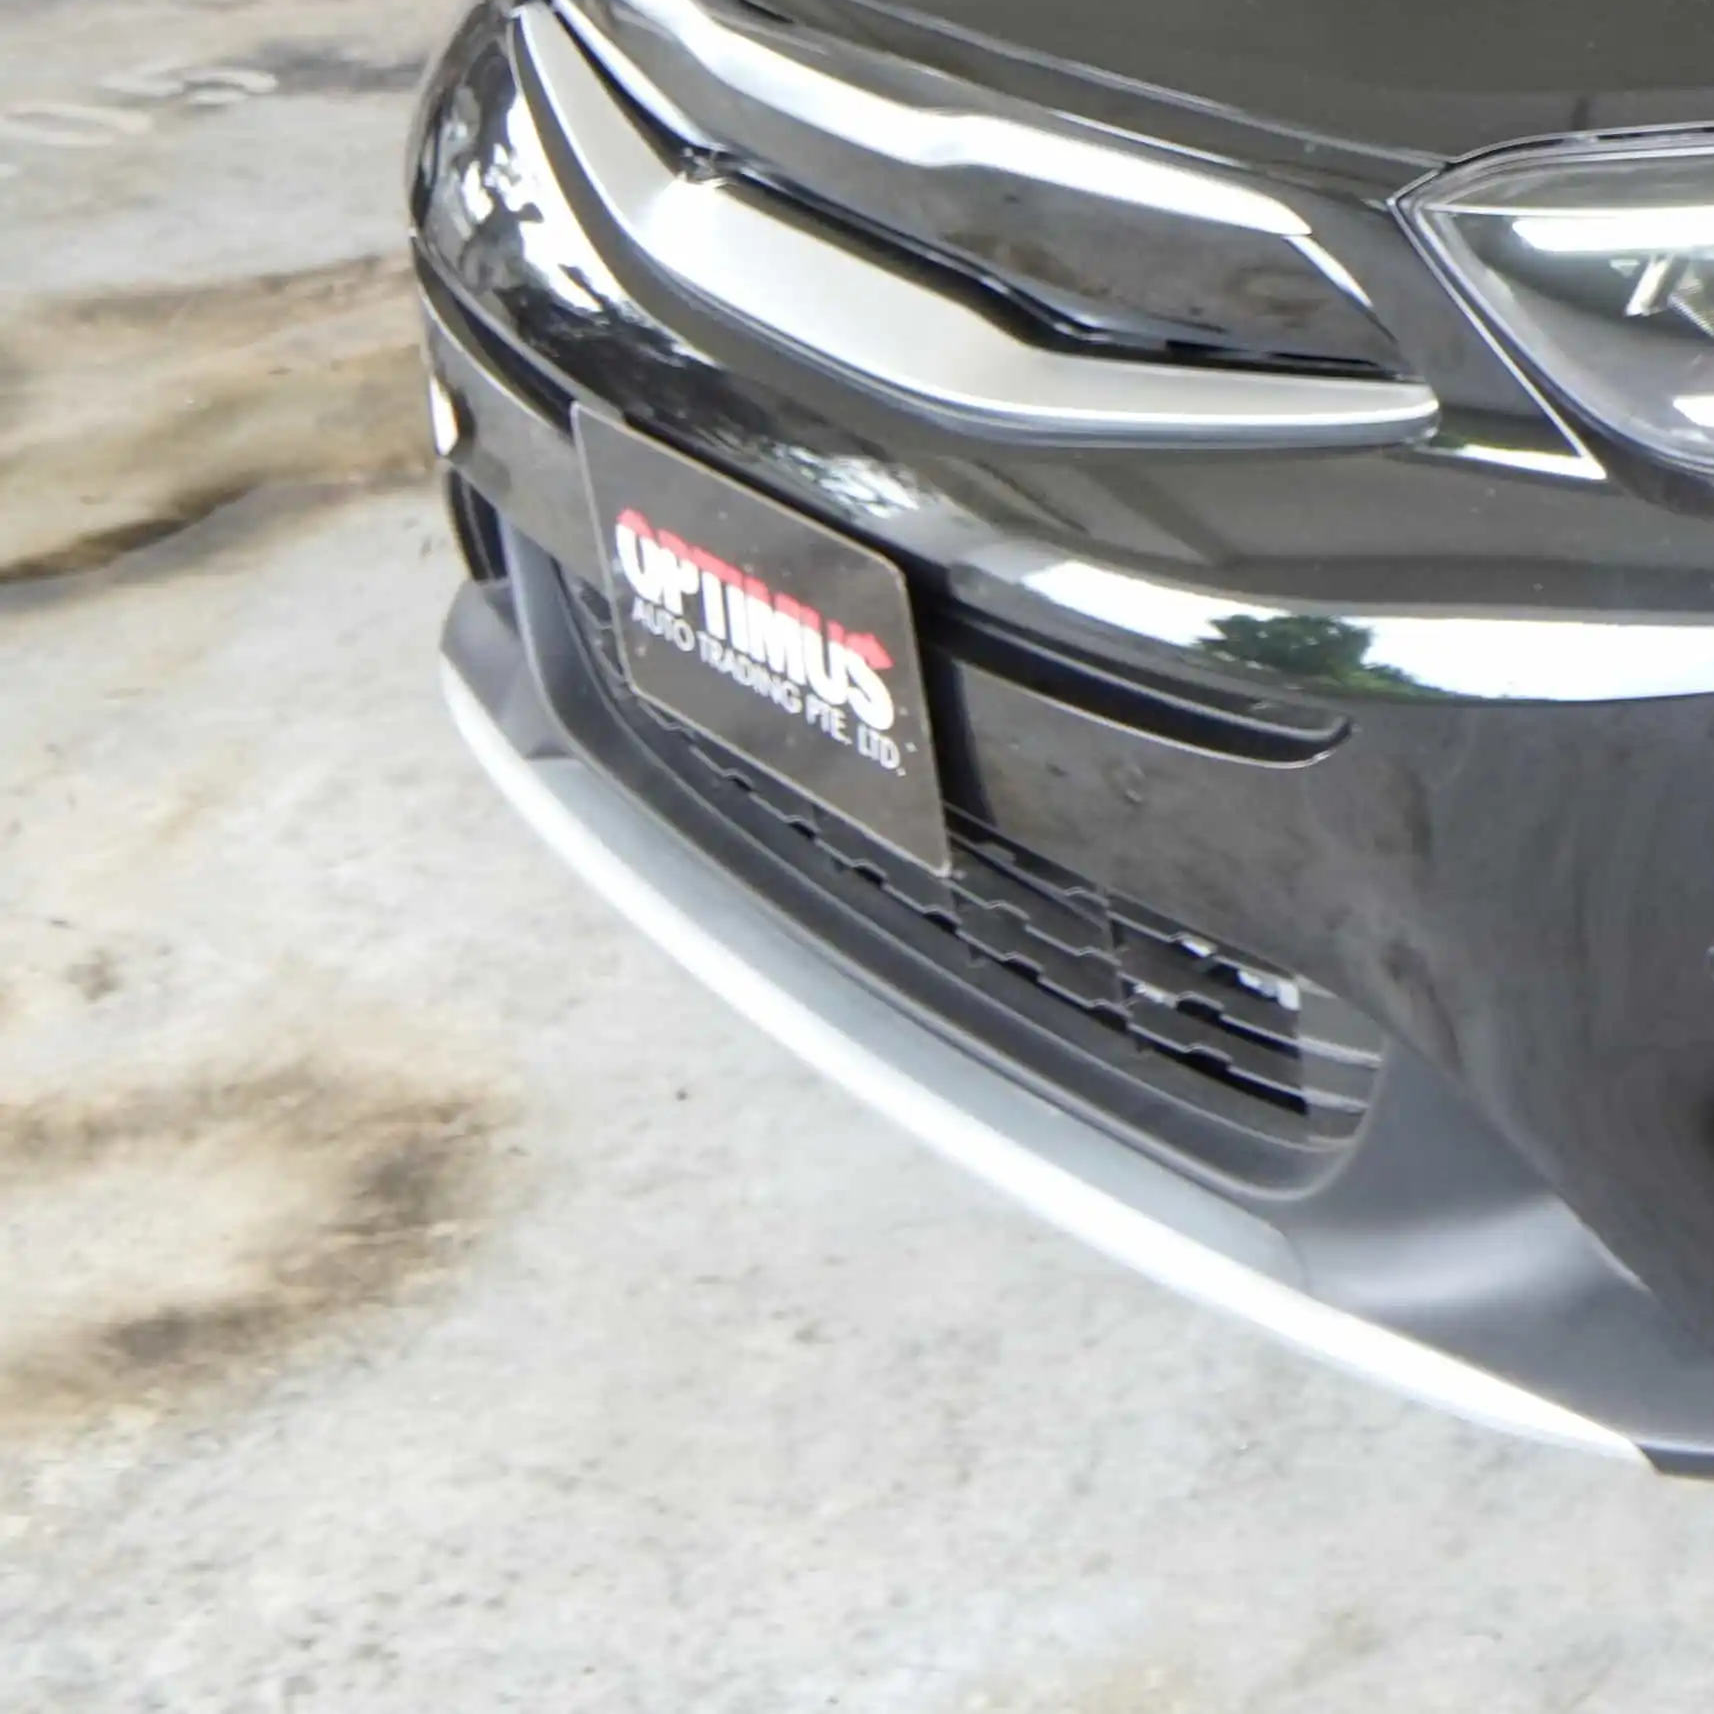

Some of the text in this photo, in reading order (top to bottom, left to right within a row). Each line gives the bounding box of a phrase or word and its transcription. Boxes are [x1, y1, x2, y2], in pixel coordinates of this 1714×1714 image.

[616, 507, 895, 731] OPTIMUS
[632, 598, 907, 778] AUTO TRADING PTE. LTD.
